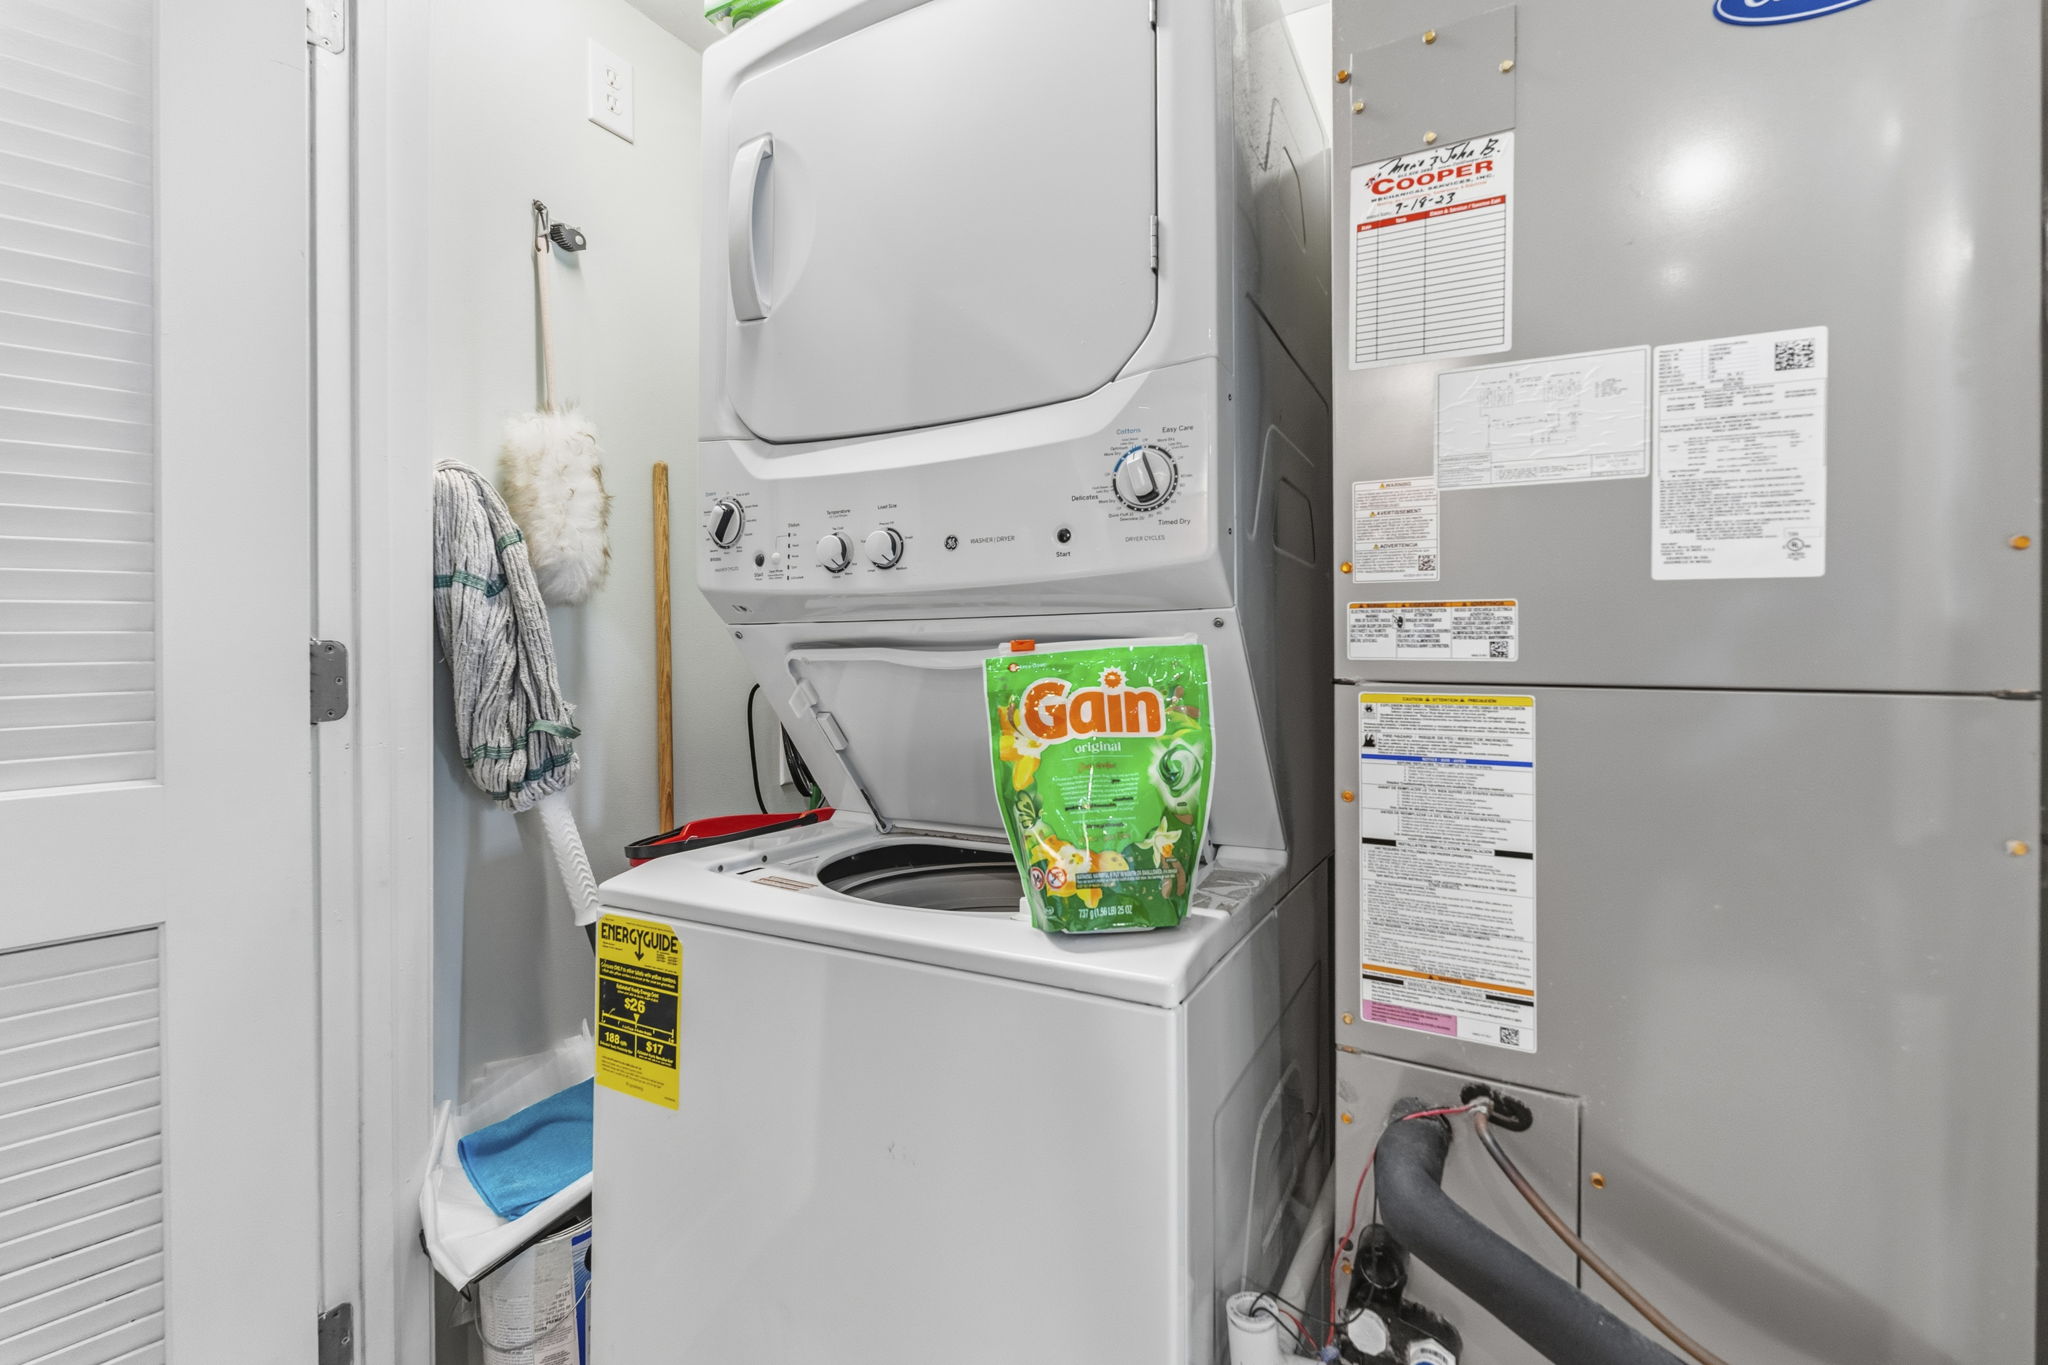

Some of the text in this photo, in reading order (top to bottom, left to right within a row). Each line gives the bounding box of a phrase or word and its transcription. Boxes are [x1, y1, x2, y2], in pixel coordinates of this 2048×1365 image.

[1371, 160, 1494, 195] COOPER
[1179, 518, 1191, 526] Dry
[1024, 671, 1162, 740] Gain
[1074, 741, 1122, 754] original
[1078, 908, 1089, 919] 737
[1117, 906, 1125, 914] 25
[1125, 905, 1133, 914] OZ
[601, 922, 679, 954] ENERGYGUIDE
[623, 997, 646, 1014] $26
[604, 1031, 620, 1045] 188
[645, 1041, 664, 1055] $17
